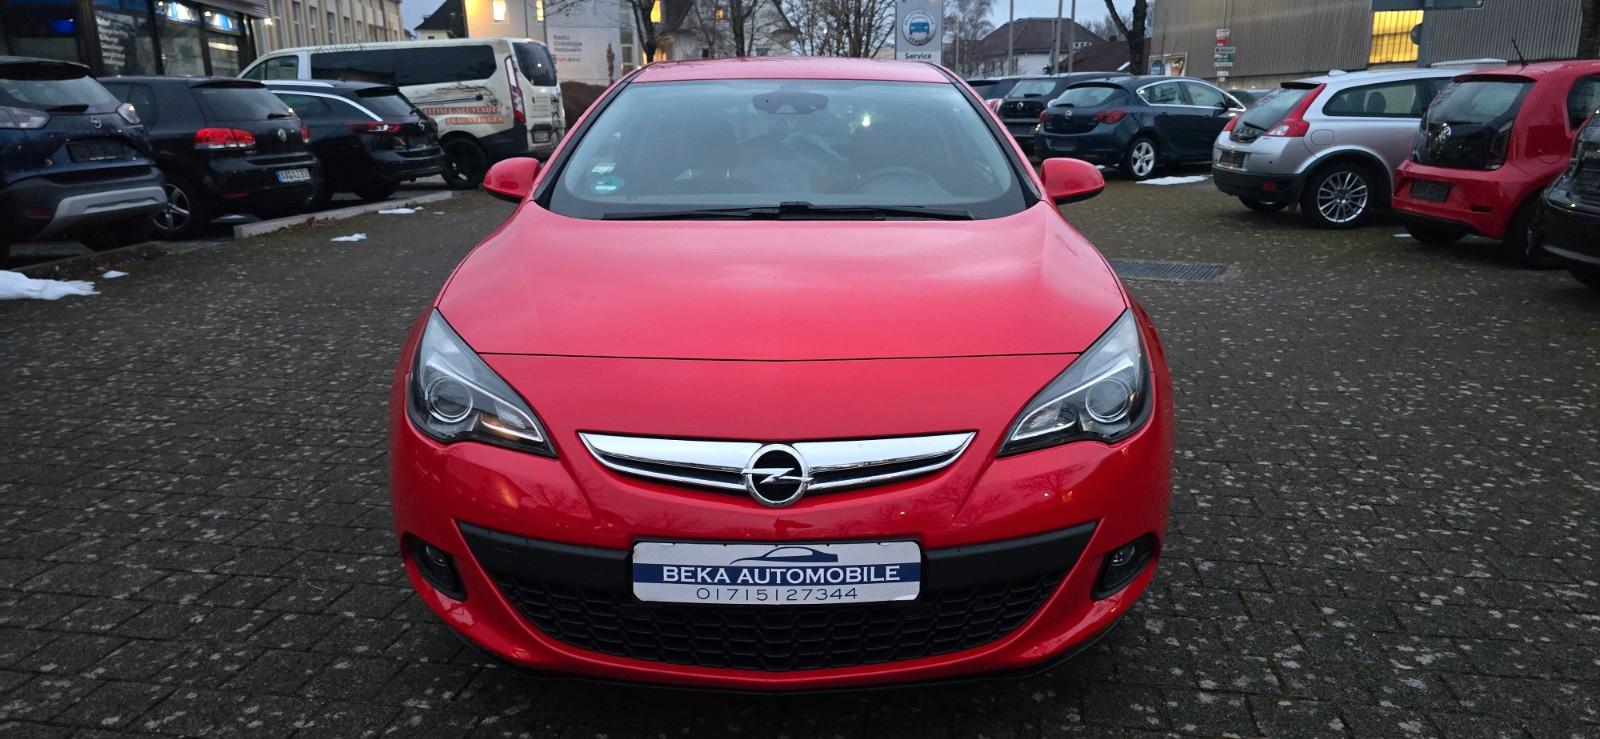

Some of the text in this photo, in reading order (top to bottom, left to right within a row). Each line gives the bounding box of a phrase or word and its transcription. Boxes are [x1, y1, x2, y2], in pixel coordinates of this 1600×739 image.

[904, 52, 932, 60] Service
[662, 565, 900, 584] BEKA AUTOMOBILE
[696, 587, 858, 602] 01715127344
